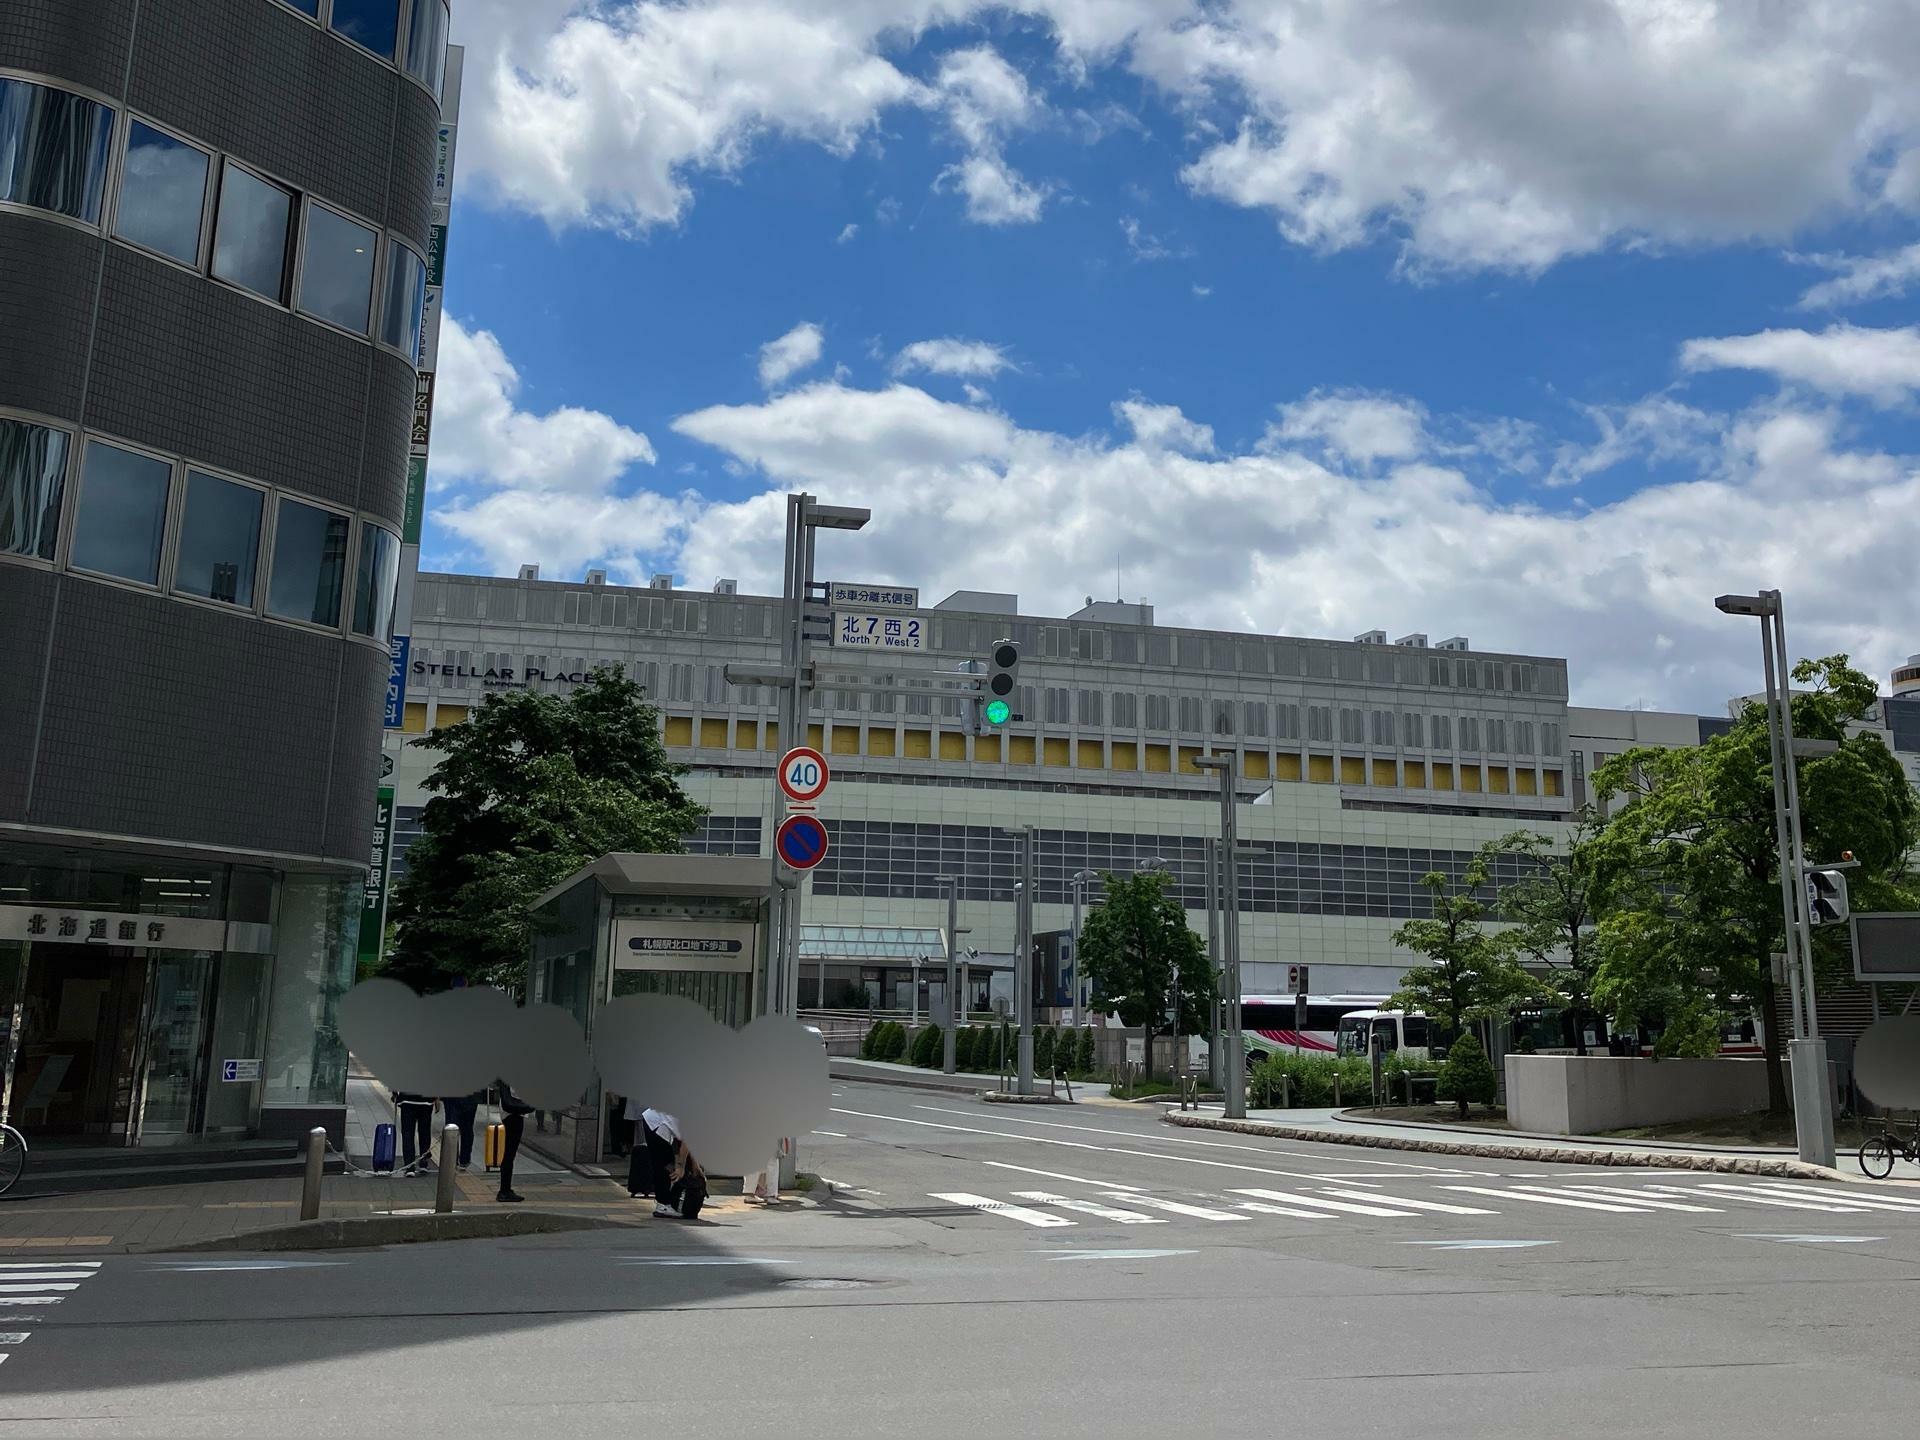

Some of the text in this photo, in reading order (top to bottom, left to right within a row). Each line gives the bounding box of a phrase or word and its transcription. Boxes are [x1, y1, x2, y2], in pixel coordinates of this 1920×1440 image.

[413, 395, 428, 441] 名門会
[836, 589, 914, 605] 歩車分離式信号
[843, 634, 920, 647] North 7 West 2
[413, 661, 595, 684] STELLAR PLACE
[790, 763, 818, 786] 40
[27, 914, 166, 945] 北海道銀行
[643, 939, 728, 951] 札幌駅北口地下歩道
